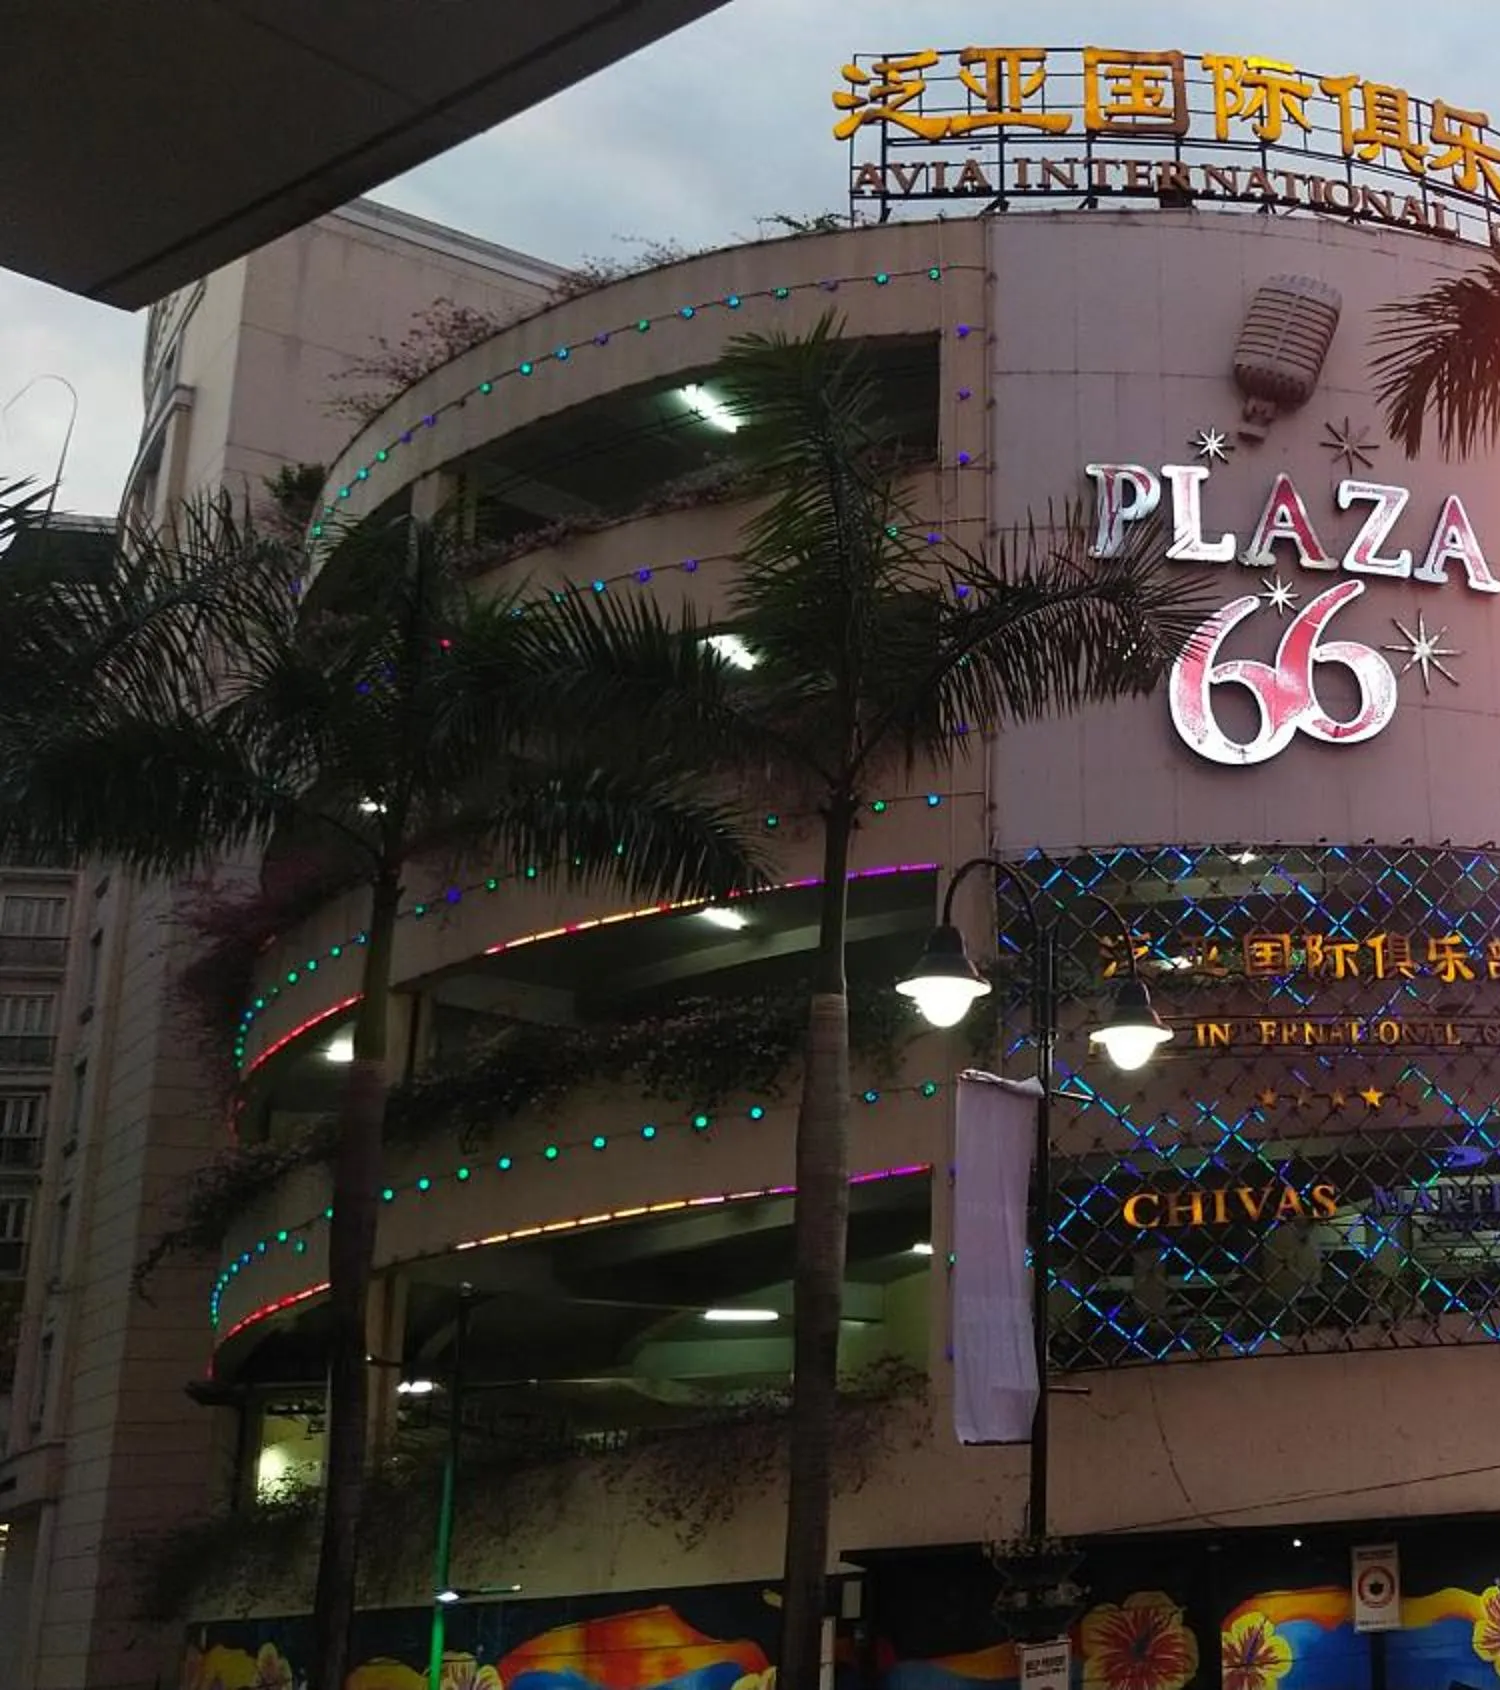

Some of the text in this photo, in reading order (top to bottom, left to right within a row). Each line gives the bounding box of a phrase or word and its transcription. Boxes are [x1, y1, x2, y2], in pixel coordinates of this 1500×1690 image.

[852, 156, 1456, 235] AVIA INTERNATIONAL
[1169, 579, 1398, 766] 66
[1122, 1184, 1337, 1229] CHIVAS
